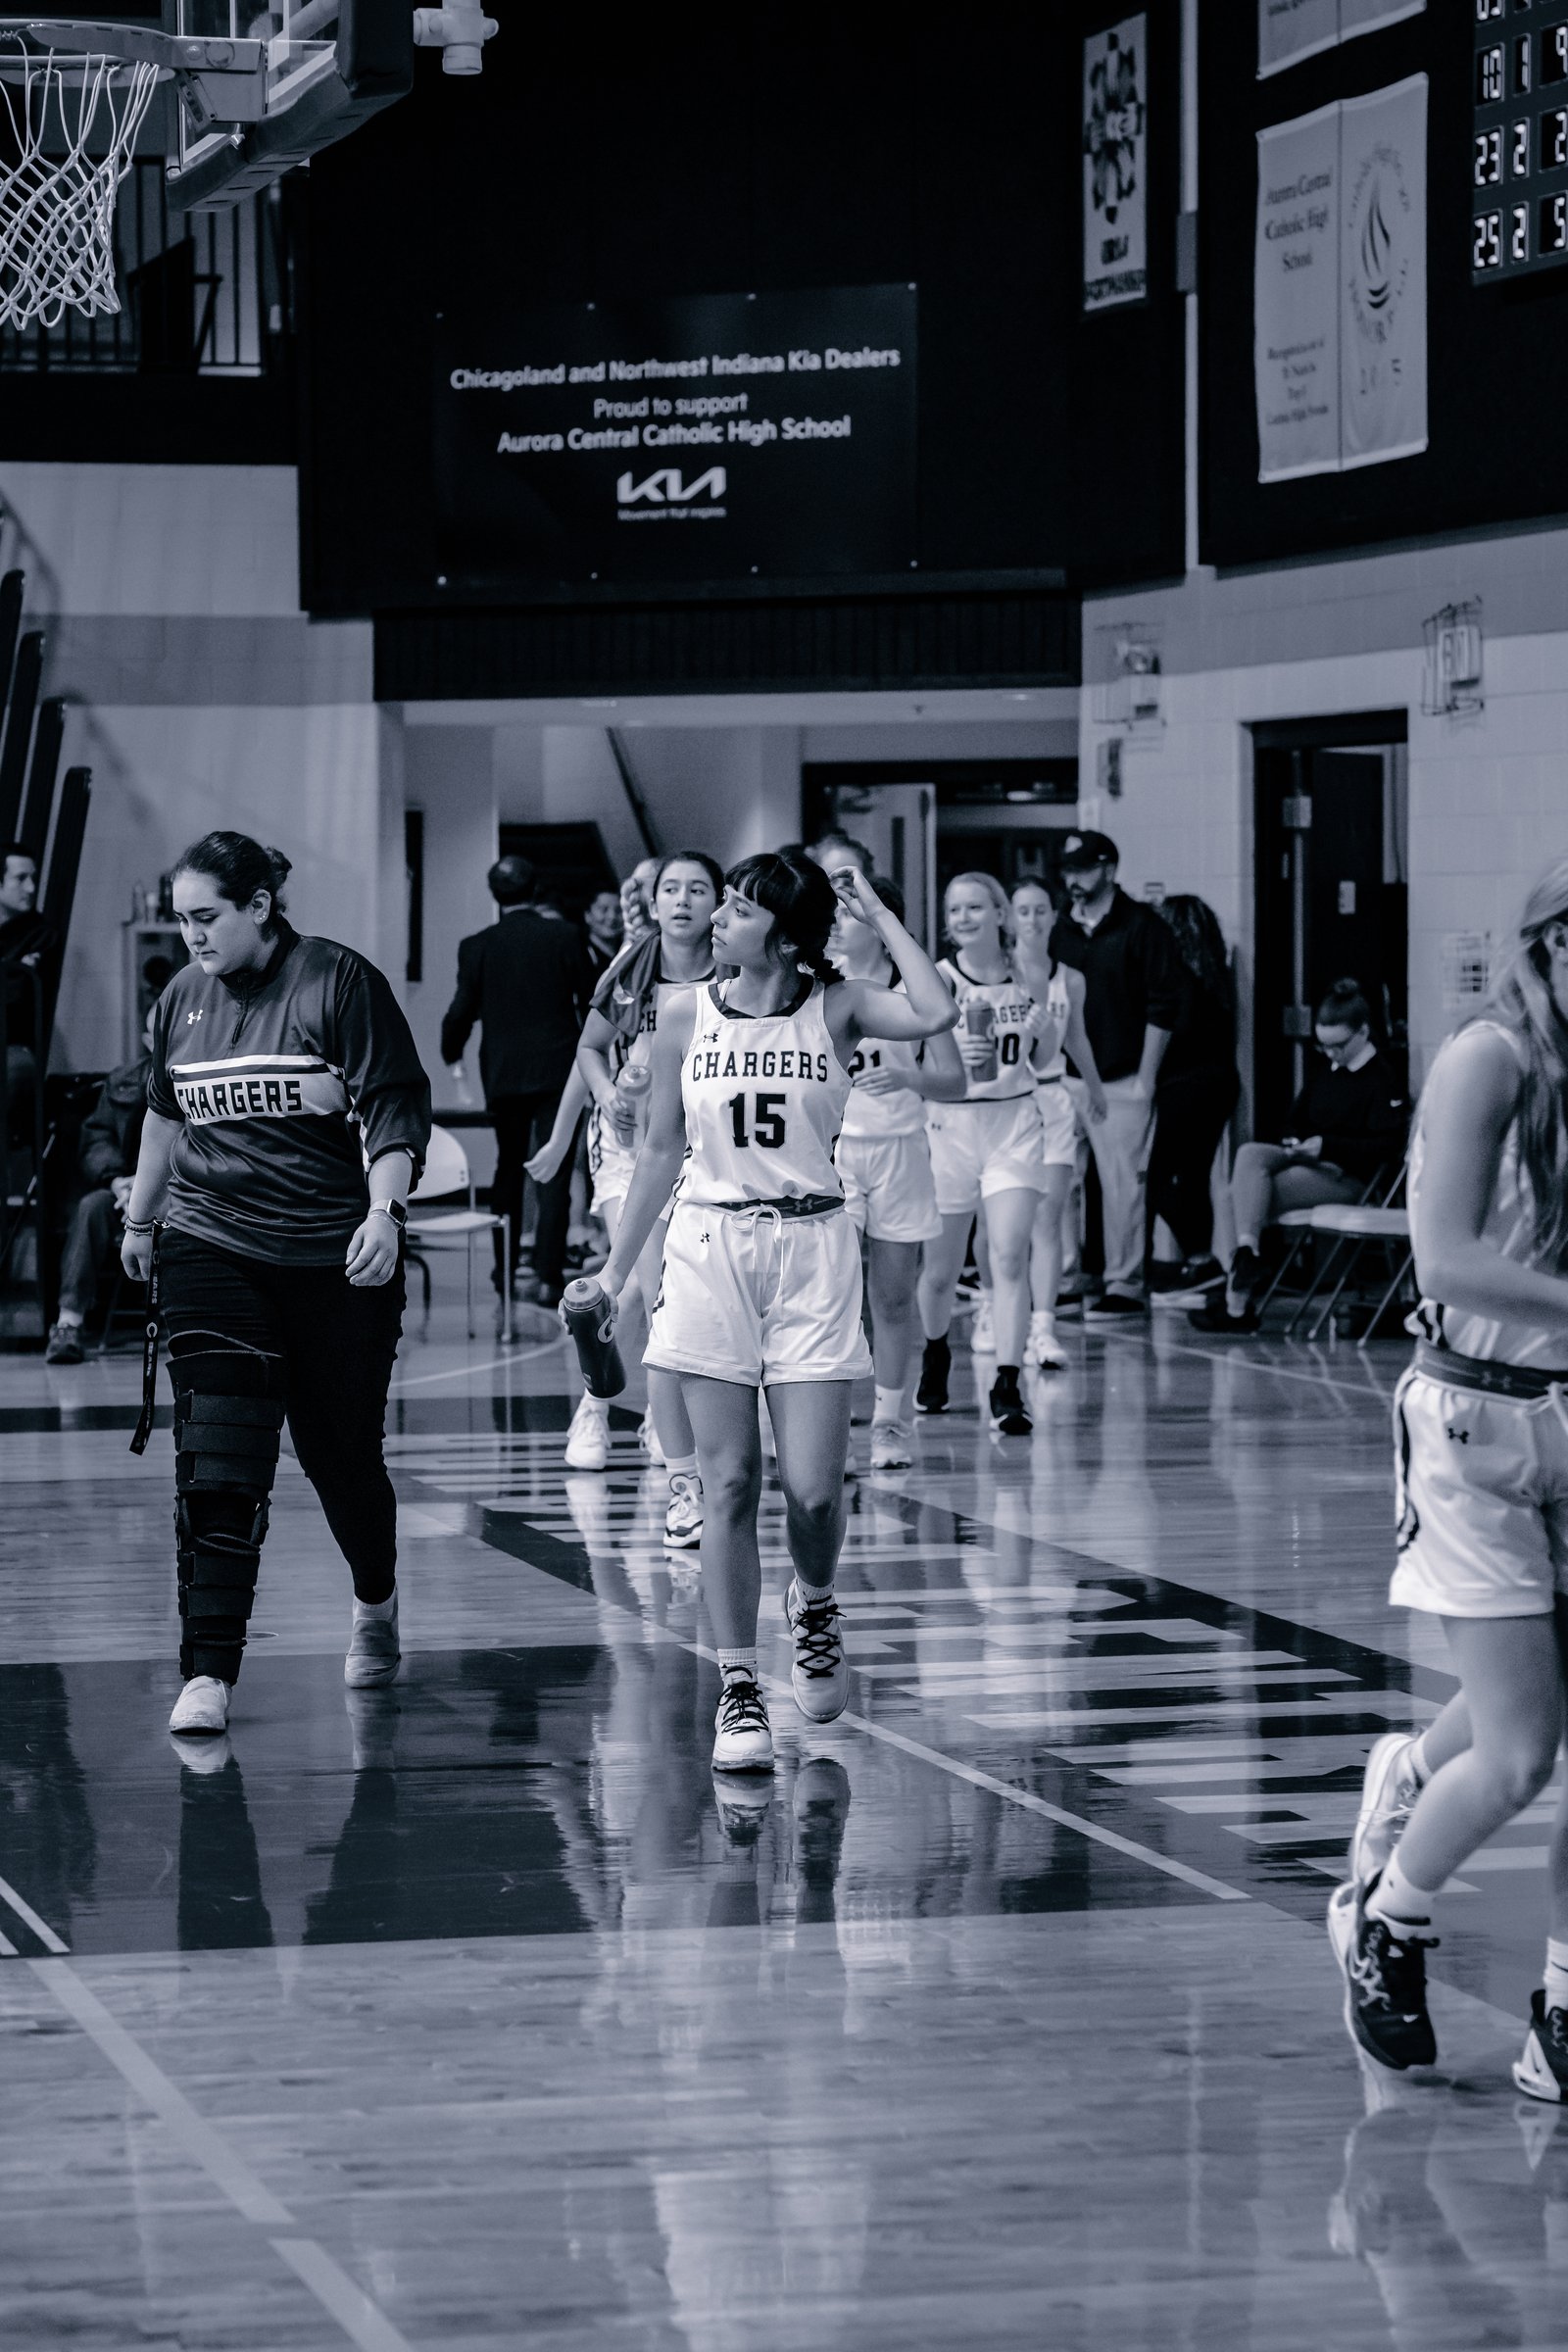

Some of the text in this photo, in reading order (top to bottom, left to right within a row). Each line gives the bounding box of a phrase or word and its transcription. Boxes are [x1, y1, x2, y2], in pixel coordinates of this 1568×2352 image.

[1521, 40, 1530, 89] 1
[1475, 110, 1567, 186] 23 2 2
[1474, 196, 1567, 268] 25 2 5
[450, 346, 900, 391] Chicagoland and Northwest Indiana Kia Dealers
[593, 392, 748, 419] Proud to support
[497, 415, 851, 454] Aurora Central Catholic High School
[693, 1051, 828, 1083] CHARGERS
[176, 1080, 302, 1119] CHARGERS
[728, 1092, 787, 1150] 15
